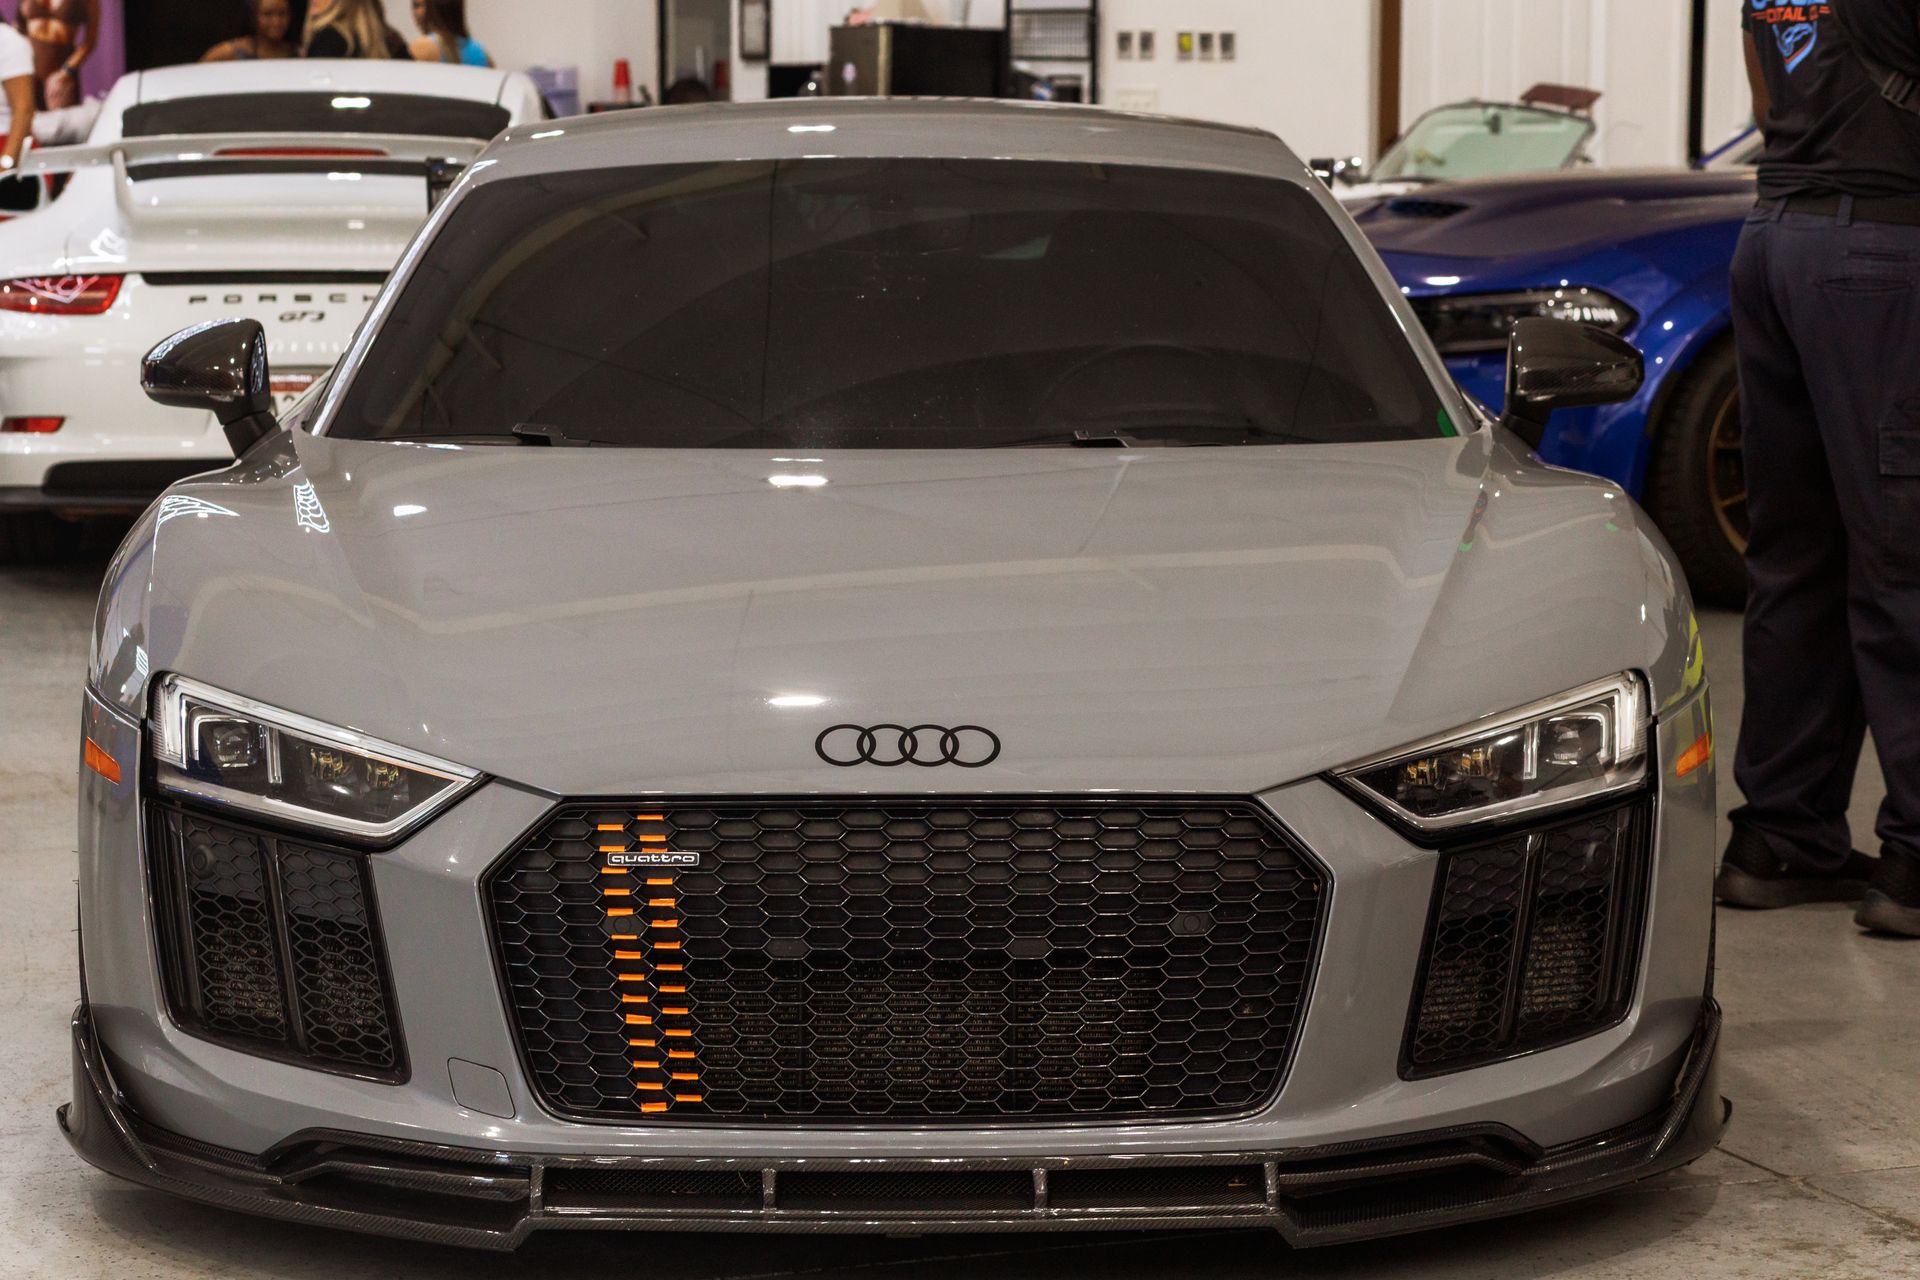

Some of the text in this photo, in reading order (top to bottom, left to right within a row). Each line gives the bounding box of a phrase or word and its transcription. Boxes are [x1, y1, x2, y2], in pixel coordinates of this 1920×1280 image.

[188, 294, 376, 304] PORSCH
[279, 310, 325, 322] GT3
[611, 853, 695, 864] quattro
